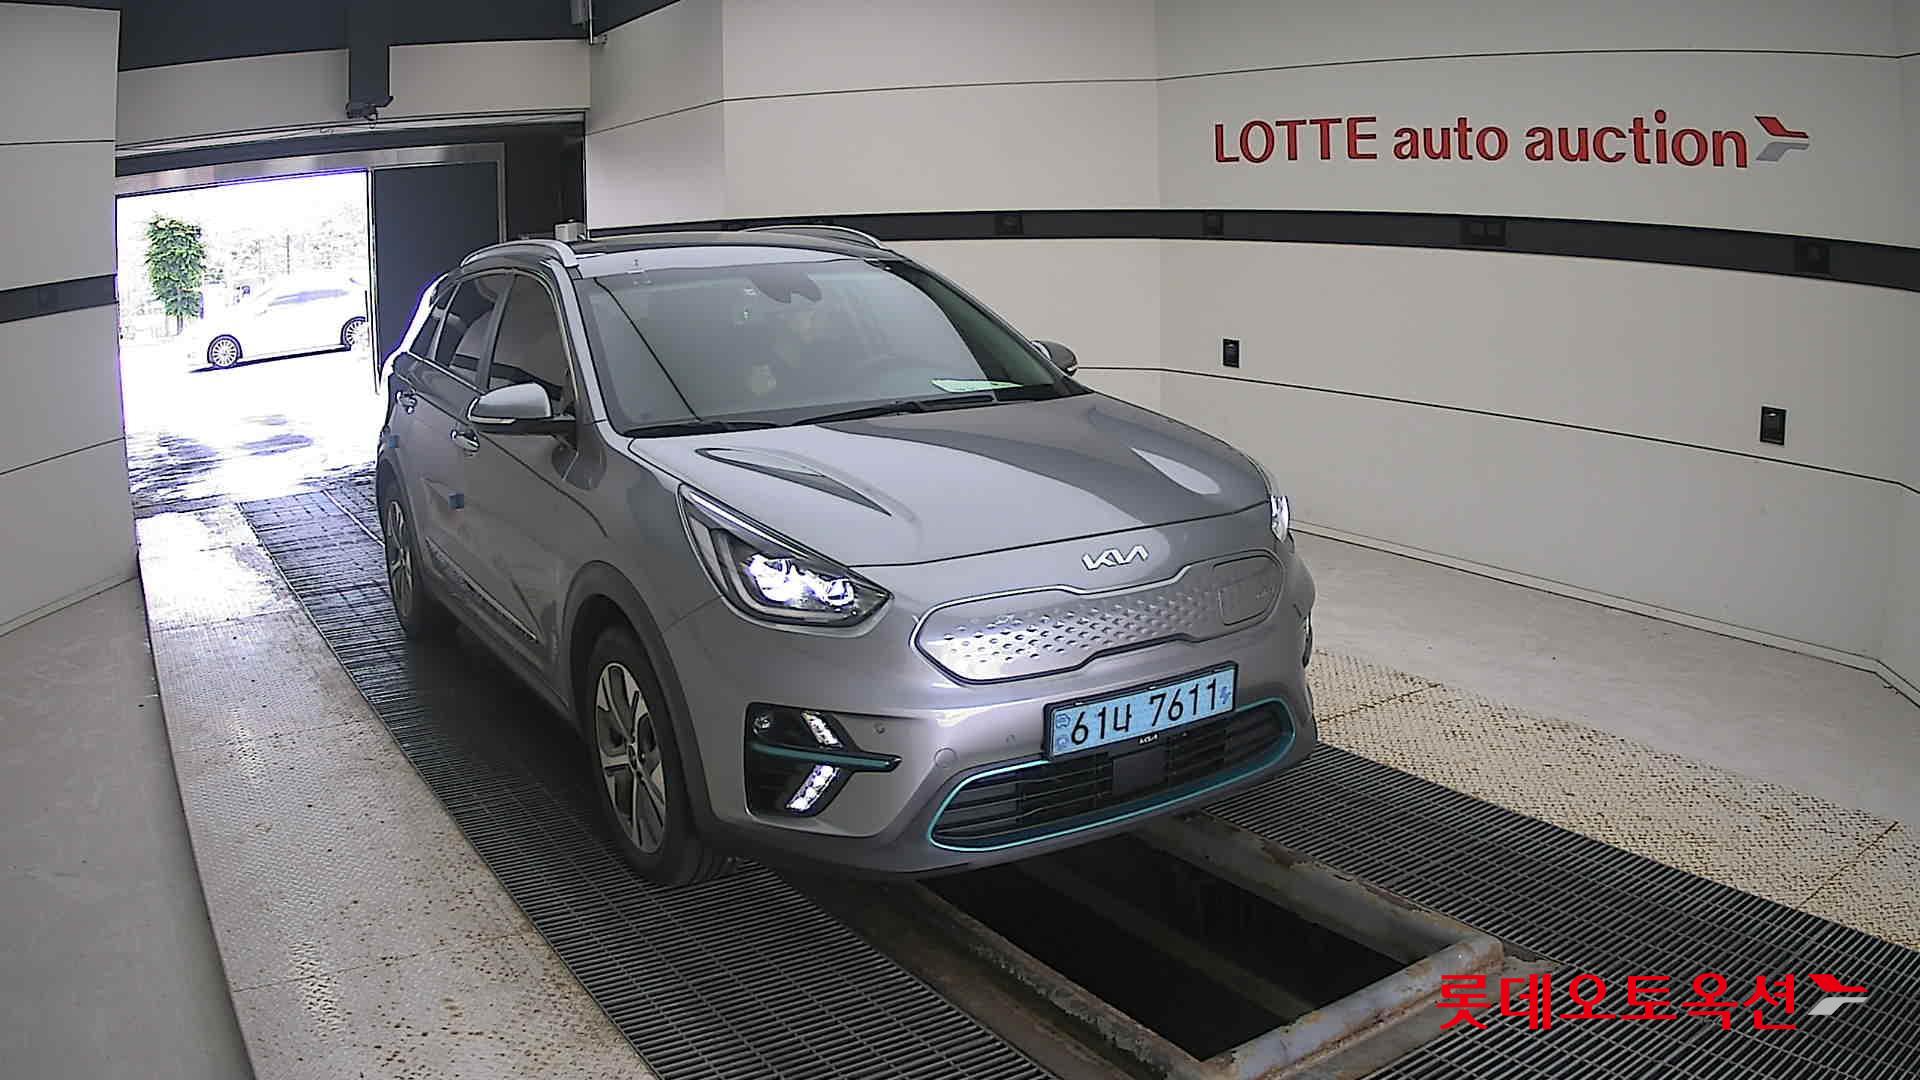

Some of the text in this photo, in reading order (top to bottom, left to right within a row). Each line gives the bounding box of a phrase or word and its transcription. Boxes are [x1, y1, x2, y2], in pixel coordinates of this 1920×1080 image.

[1214, 110, 1748, 168] LOTTE auto auction
[1082, 545, 1148, 571] KIA
[1071, 679, 1217, 745] 61나 7611
